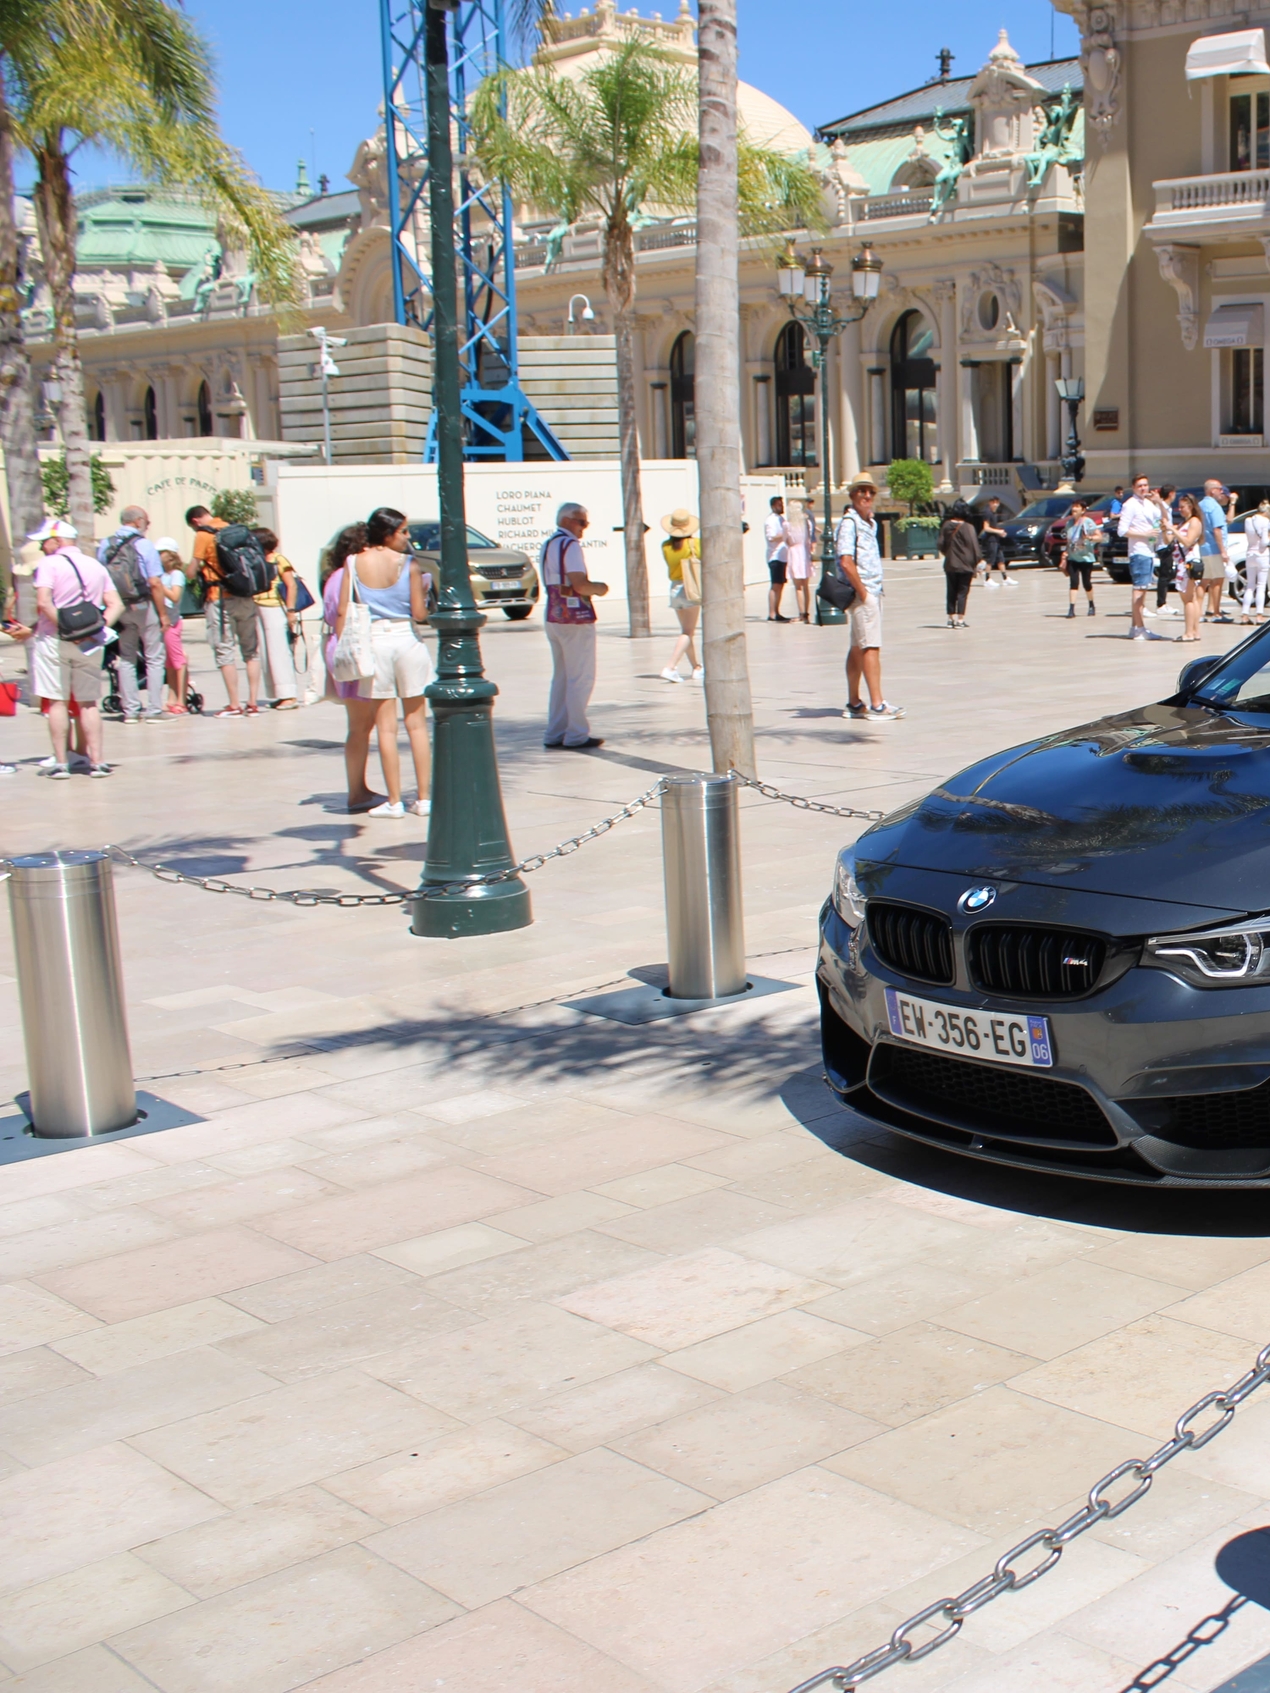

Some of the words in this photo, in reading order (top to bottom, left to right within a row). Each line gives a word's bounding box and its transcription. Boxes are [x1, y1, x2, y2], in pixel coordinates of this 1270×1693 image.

[1213, 337, 1235, 346] OMEGA
[175, 476, 187, 486] DE
[496, 491, 522, 500] LORO
[524, 490, 552, 499] PIANA
[497, 503, 541, 513] CHAUMET
[498, 516, 534, 526] HUBLOT
[498, 529, 539, 539] RICHARD
[899, 999, 1027, 1058] EW-356-EG
[1031, 1042, 1049, 1060] 06
